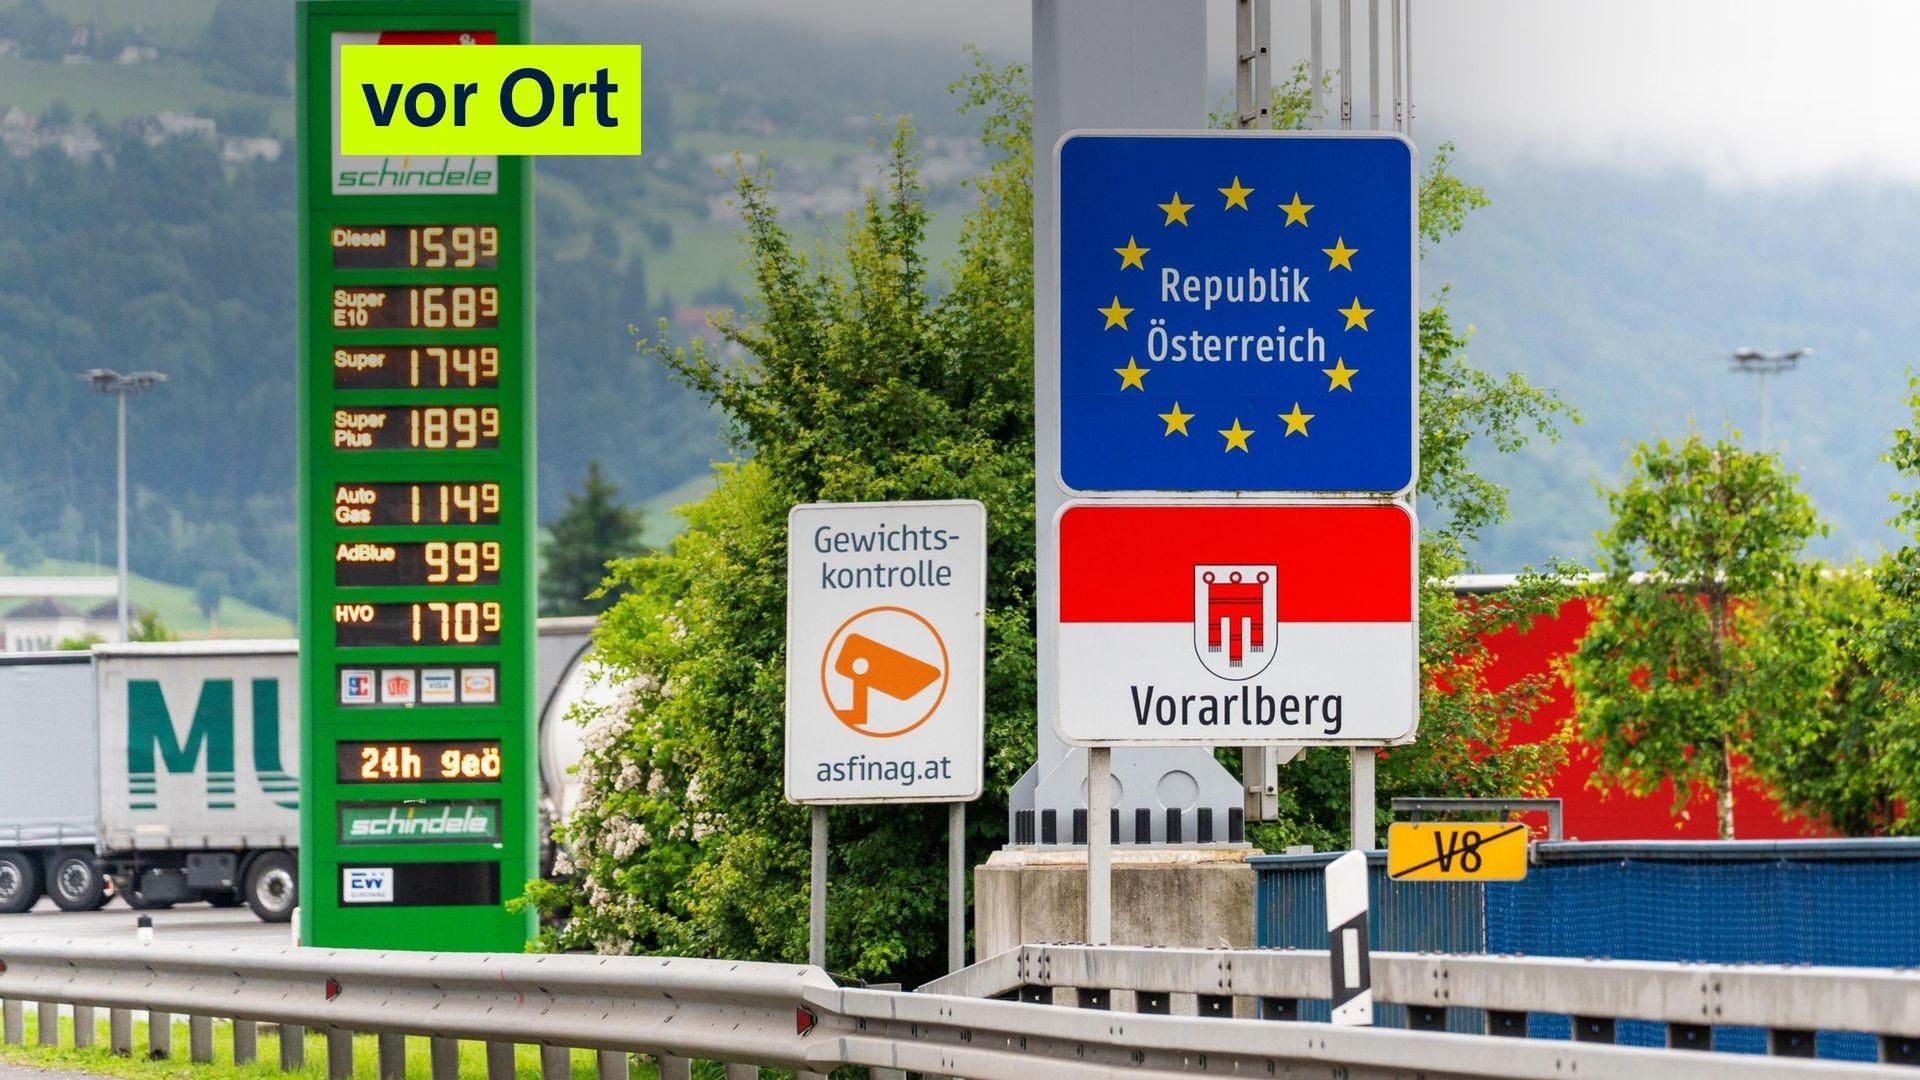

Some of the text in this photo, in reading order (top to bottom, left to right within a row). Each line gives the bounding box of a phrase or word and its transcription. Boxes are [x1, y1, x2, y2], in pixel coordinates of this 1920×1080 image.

[337, 157, 492, 187] schindele
[333, 227, 498, 268] Diesel 1599
[333, 287, 498, 328] Super 1689
[1160, 266, 1311, 310] Republik
[333, 308, 369, 327] E10
[1147, 318, 1326, 363] Österreich
[334, 347, 499, 388] Super 1749
[334, 407, 499, 449] Super 1899
[334, 431, 373, 448] Plus
[335, 483, 500, 524] Auto 1149
[335, 506, 371, 523] Gas
[814, 523, 960, 554] Gewichts-
[335, 542, 500, 583] AdBlue 999
[821, 560, 952, 590] kontrolle
[335, 602, 500, 642] HVO 1709
[1130, 685, 1344, 735] Vorarlberg
[361, 746, 501, 779] 24h geö
[816, 755, 952, 786] asfinag.at
[350, 807, 488, 835] schindele
[1433, 830, 1482, 874] V8
